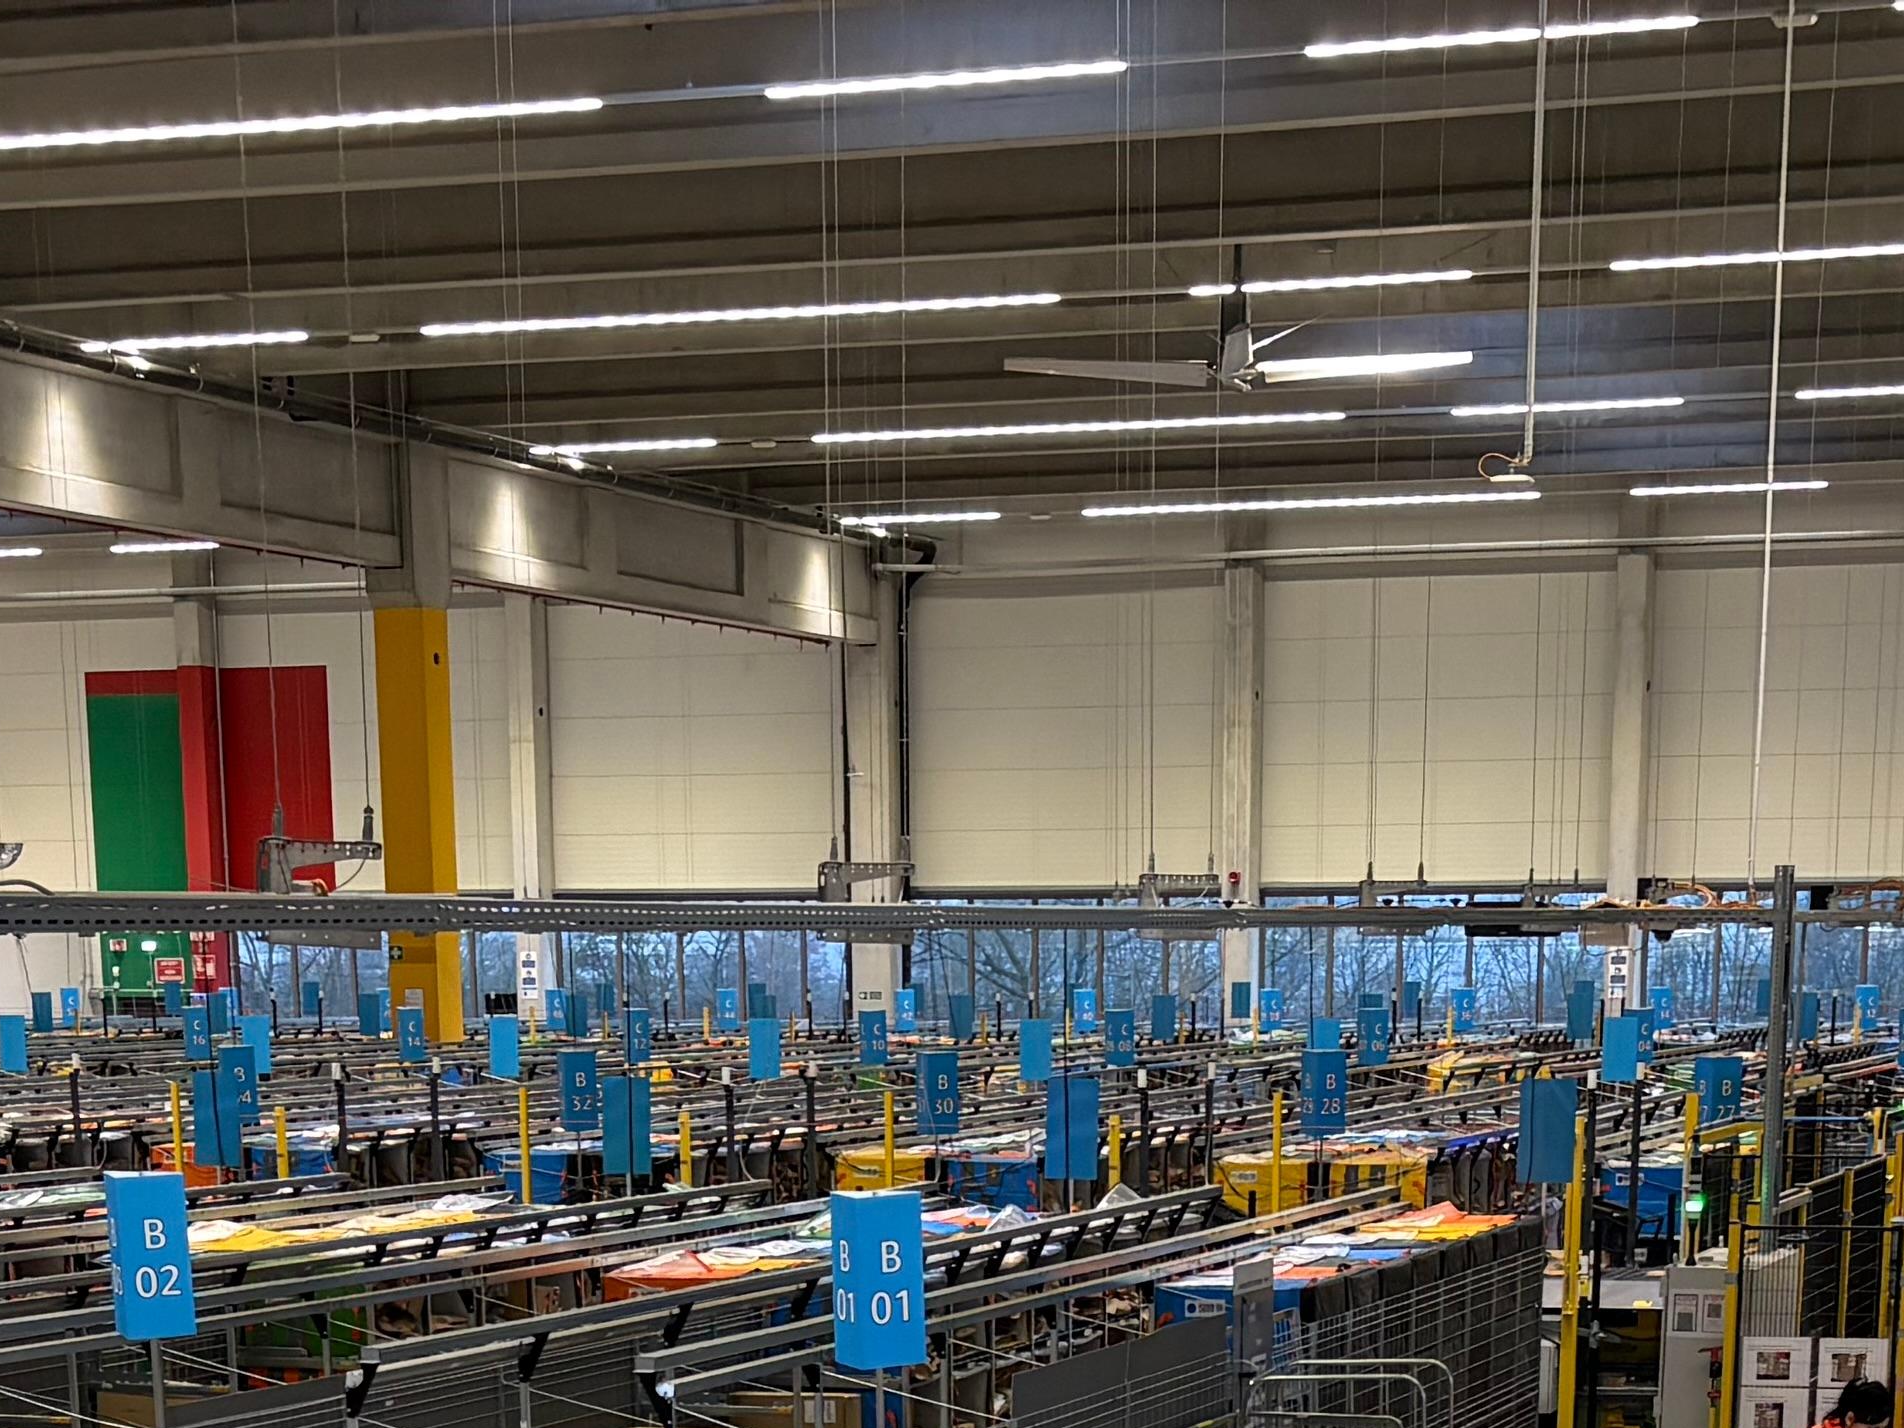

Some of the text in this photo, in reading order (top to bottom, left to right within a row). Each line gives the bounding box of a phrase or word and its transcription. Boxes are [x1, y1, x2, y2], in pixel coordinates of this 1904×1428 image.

[575, 1072, 587, 1087] B
[938, 1073, 949, 1090] B
[1325, 1073, 1337, 1090] B
[1721, 1080, 1732, 1097] B
[572, 1094, 593, 1111] 32
[934, 1097, 954, 1114] 30
[1320, 1097, 1341, 1115] 28
[1716, 1105, 1736, 1120] 27
[143, 1218, 167, 1250] B
[839, 1239, 851, 1273] B
[880, 1240, 903, 1274] B
[133, 1265, 182, 1298] 02
[836, 1288, 855, 1325] 01
[870, 1289, 911, 1326] 01
